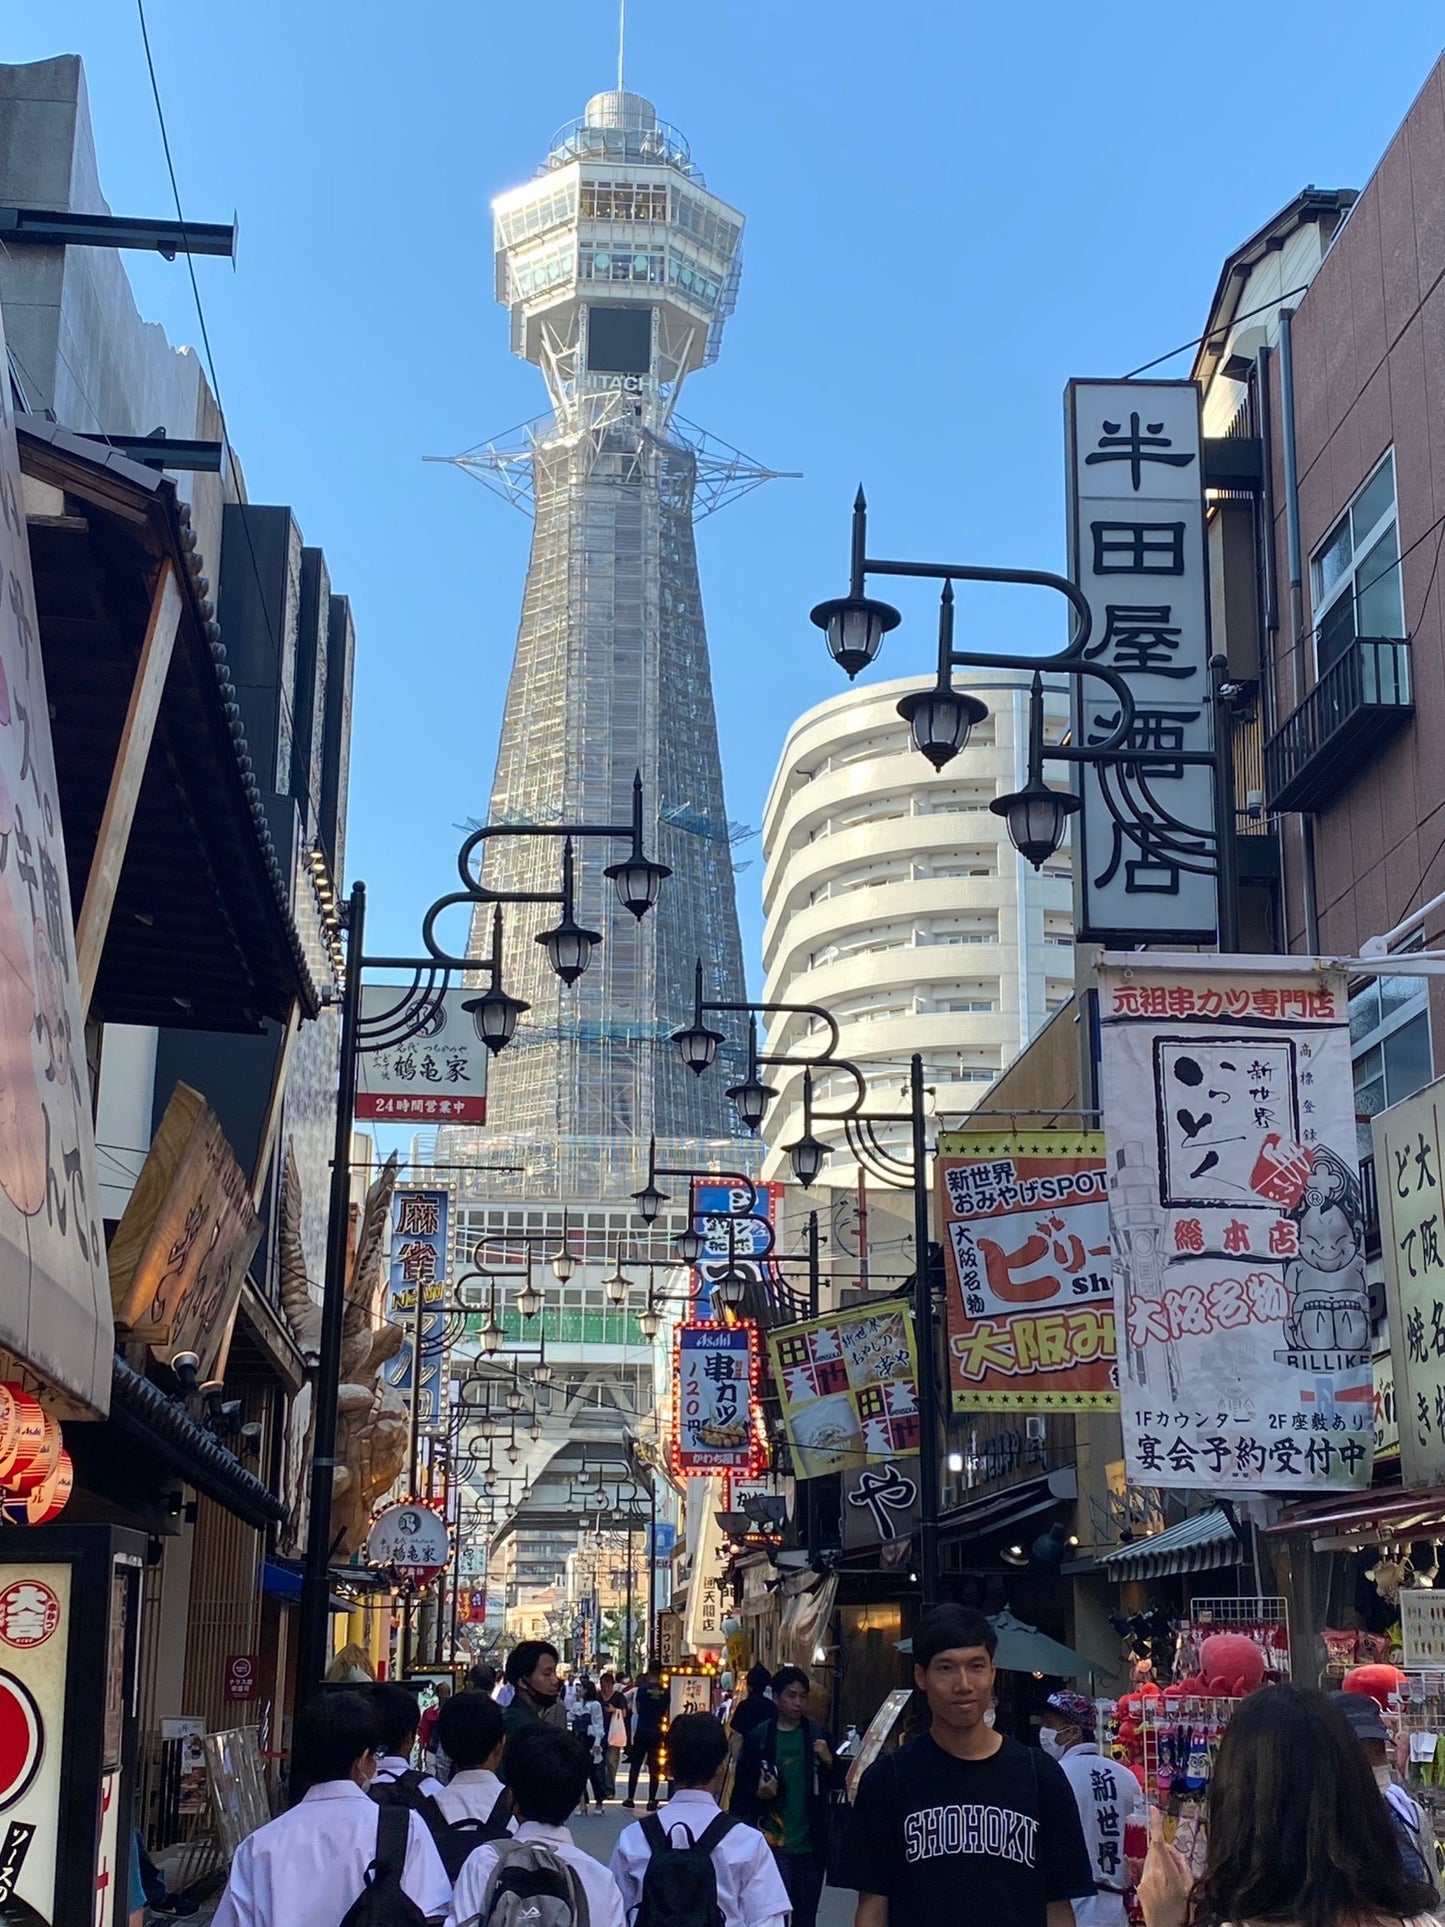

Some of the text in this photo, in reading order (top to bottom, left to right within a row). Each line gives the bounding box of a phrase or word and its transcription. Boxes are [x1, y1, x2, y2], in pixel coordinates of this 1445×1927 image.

[583, 375, 659, 391] HITACHI
[1085, 412, 1204, 895] 半田屋酒店
[1112, 985, 1336, 1019] 元祖串カツ専門店
[375, 1098, 466, 1114] 24時間営業中
[1247, 1060, 1280, 1128] 新世界
[948, 1162, 1015, 1193] 新世界
[953, 1170, 1107, 1214] おみやげSPOT
[395, 1195, 440, 1283] 麻雀
[955, 1225, 985, 1314] 大阪名物
[1128, 1272, 1293, 1348] 大阪名物
[696, 1333, 732, 1348] Asahi
[703, 1352, 738, 1426] 串カツ
[1135, 1411, 1252, 1431] 1Fカウンター
[1268, 1411, 1365, 1432] 2F座敷あり
[1136, 1433, 1367, 1475] 宴会予約受付中
[849, 1464, 917, 1540] や
[5, 1586, 48, 1639] 大吉
[904, 1805, 1040, 1868] SHOHOKU
[1090, 1768, 1121, 1875] 新世界
